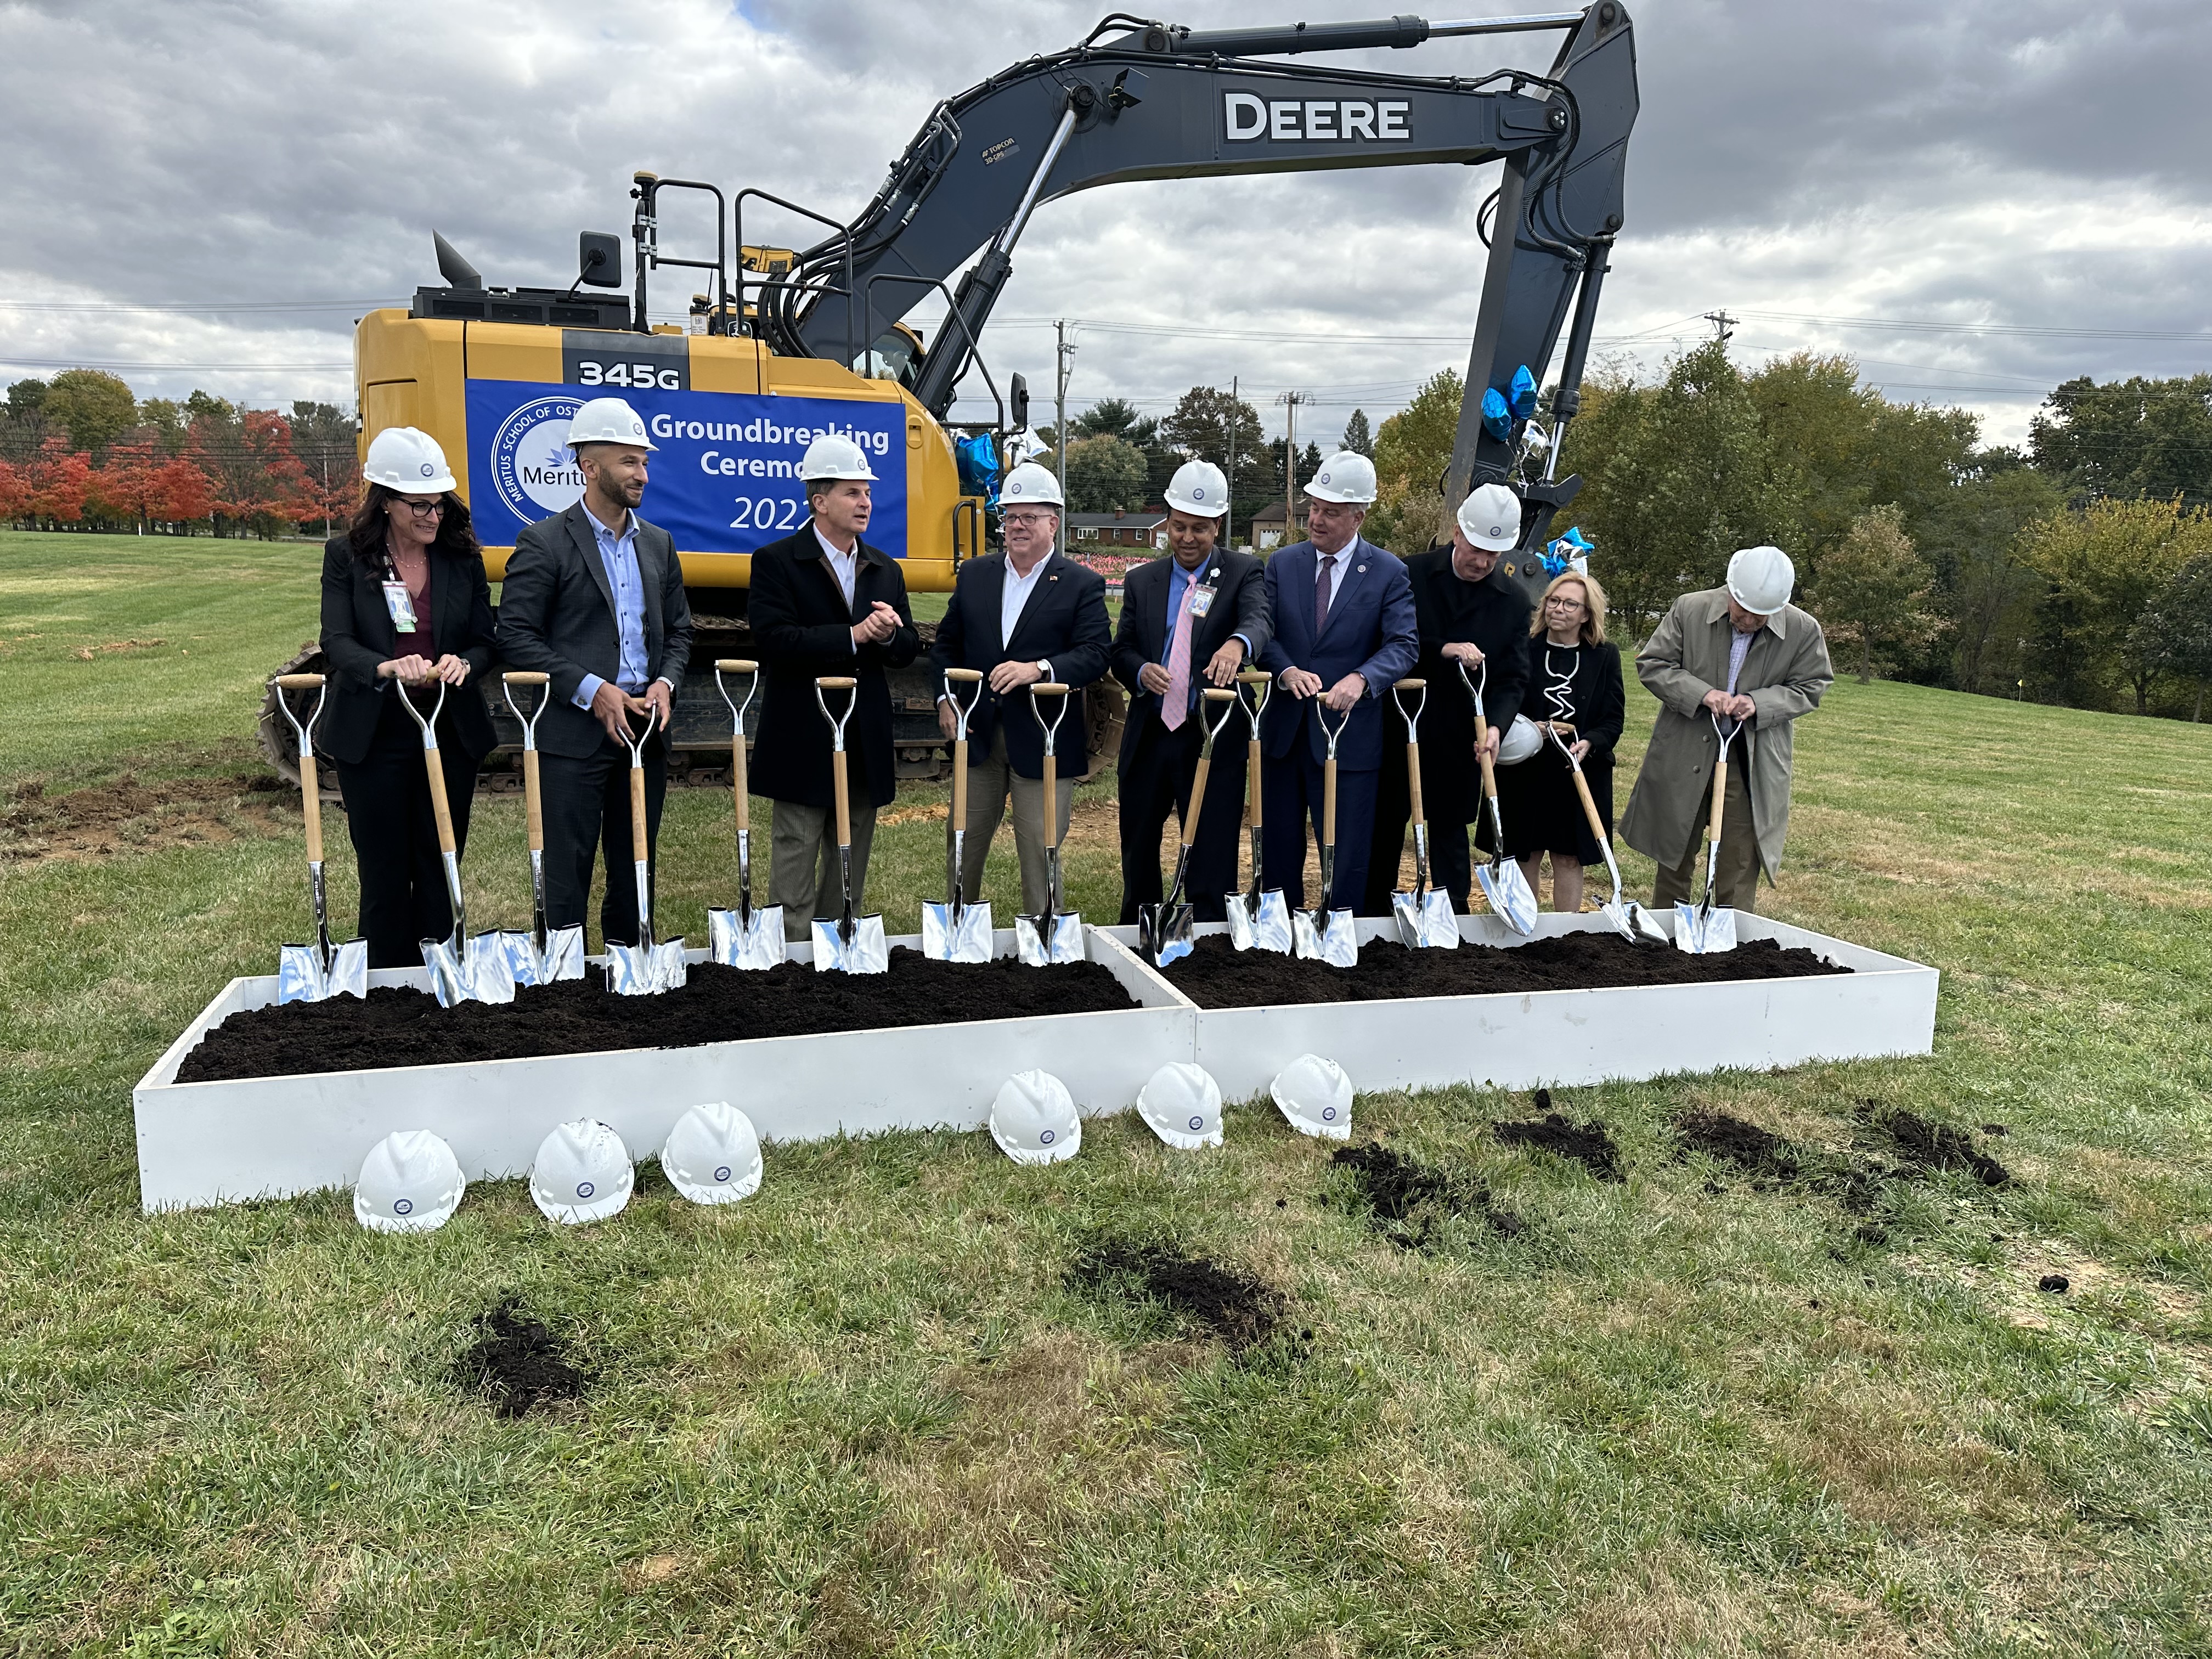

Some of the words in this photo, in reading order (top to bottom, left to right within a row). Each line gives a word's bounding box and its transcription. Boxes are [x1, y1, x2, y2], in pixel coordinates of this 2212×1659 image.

[1225, 93, 1409, 139] DEERE
[988, 137, 1015, 154] TOPCON
[579, 362, 679, 390] 345G
[535, 407, 550, 419] OF
[556, 405, 579, 417] OST
[503, 414, 536, 452] SCHOOL
[523, 466, 587, 486] Meritu
[700, 450, 804, 479] Ceremo
[500, 455, 524, 503] MERITUS
